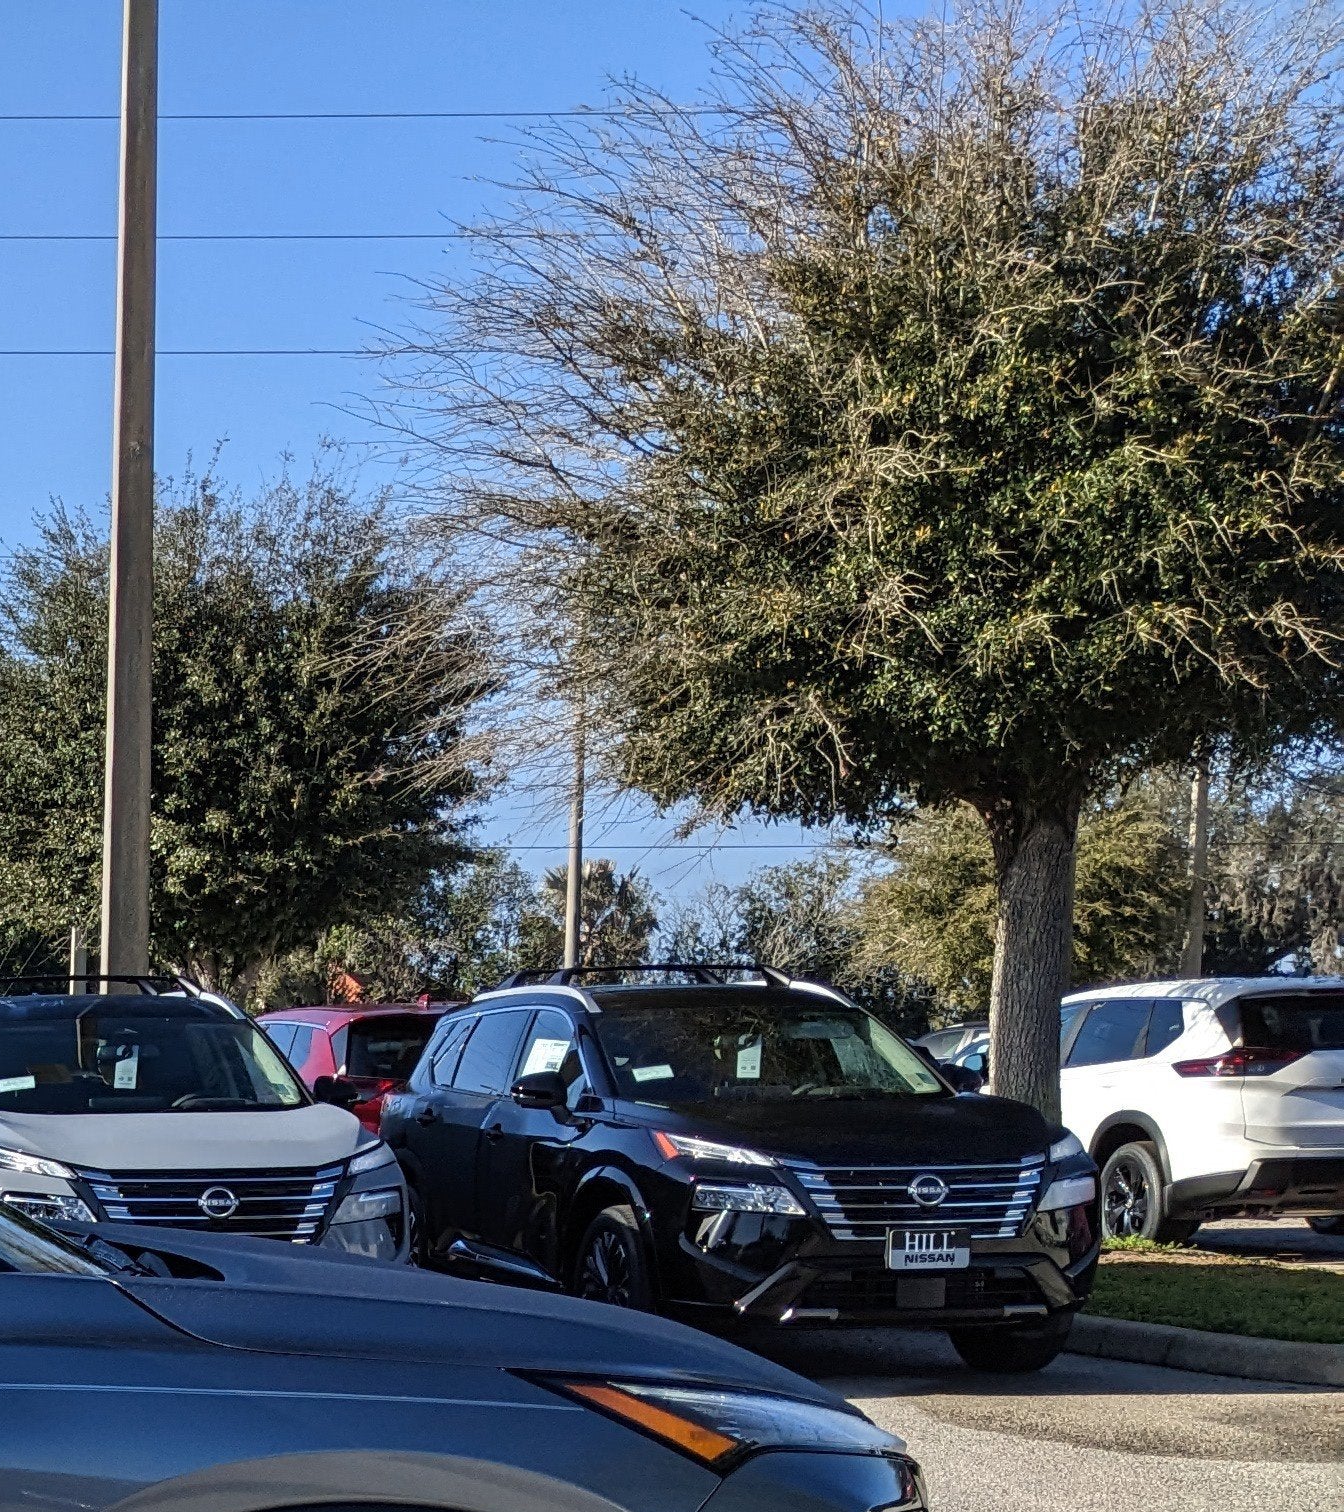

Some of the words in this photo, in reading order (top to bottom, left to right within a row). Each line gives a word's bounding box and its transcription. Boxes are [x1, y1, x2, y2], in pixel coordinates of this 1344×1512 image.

[907, 1186, 950, 1194] NISSAN
[198, 1199, 240, 1207] NISSAN
[905, 1232, 956, 1253] HILL
[904, 1254, 956, 1265] NISSAN
